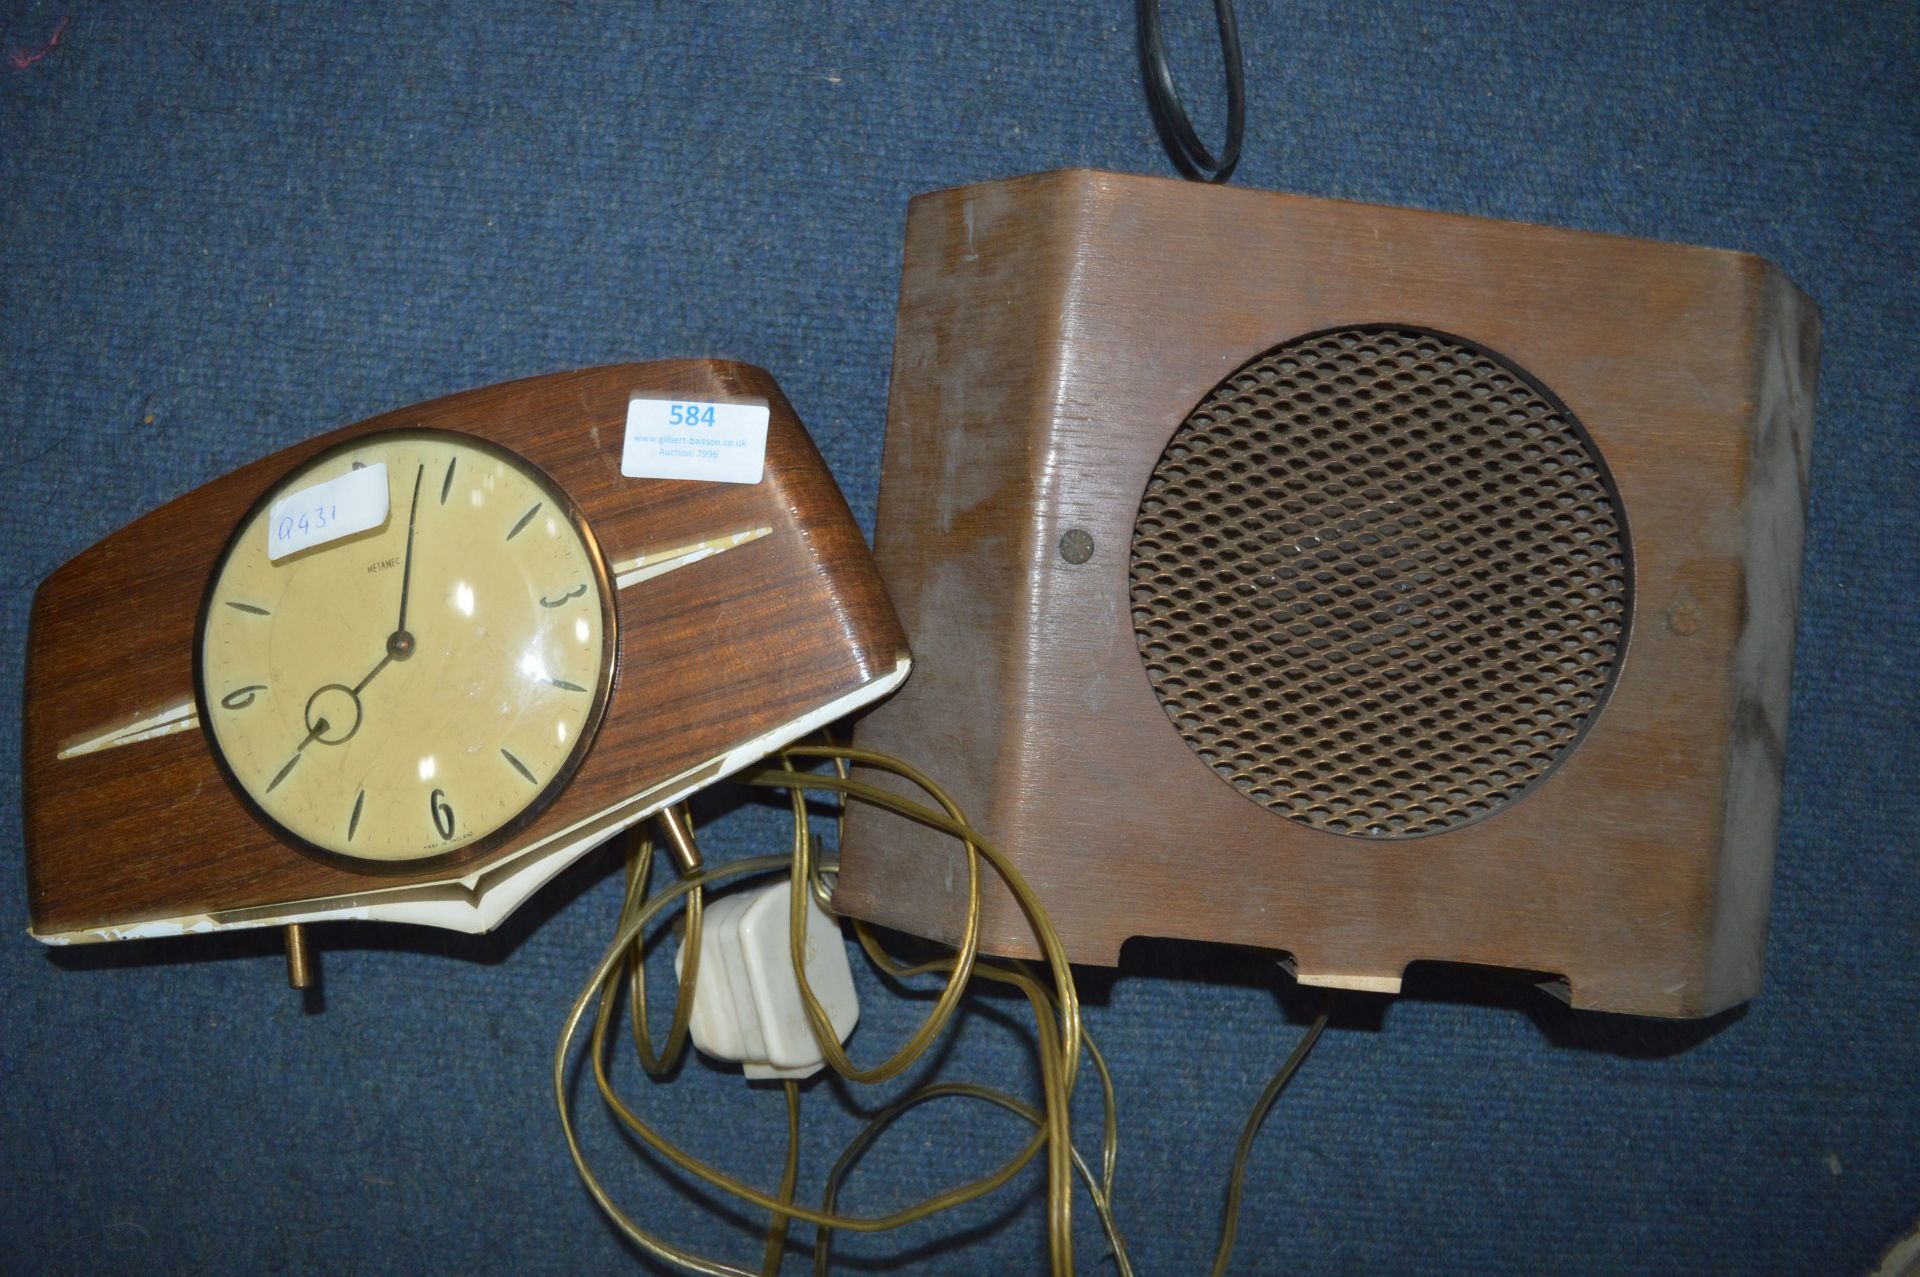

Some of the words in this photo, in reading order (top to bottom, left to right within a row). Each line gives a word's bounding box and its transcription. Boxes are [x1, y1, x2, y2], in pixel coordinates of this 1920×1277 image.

[669, 404, 716, 427] 584
[633, 433, 747, 448] www.gilbert-baitson.co.uk
[658, 447, 694, 458] Auction:
[367, 556, 401, 574] METAMEC
[430, 788, 455, 841] 6
